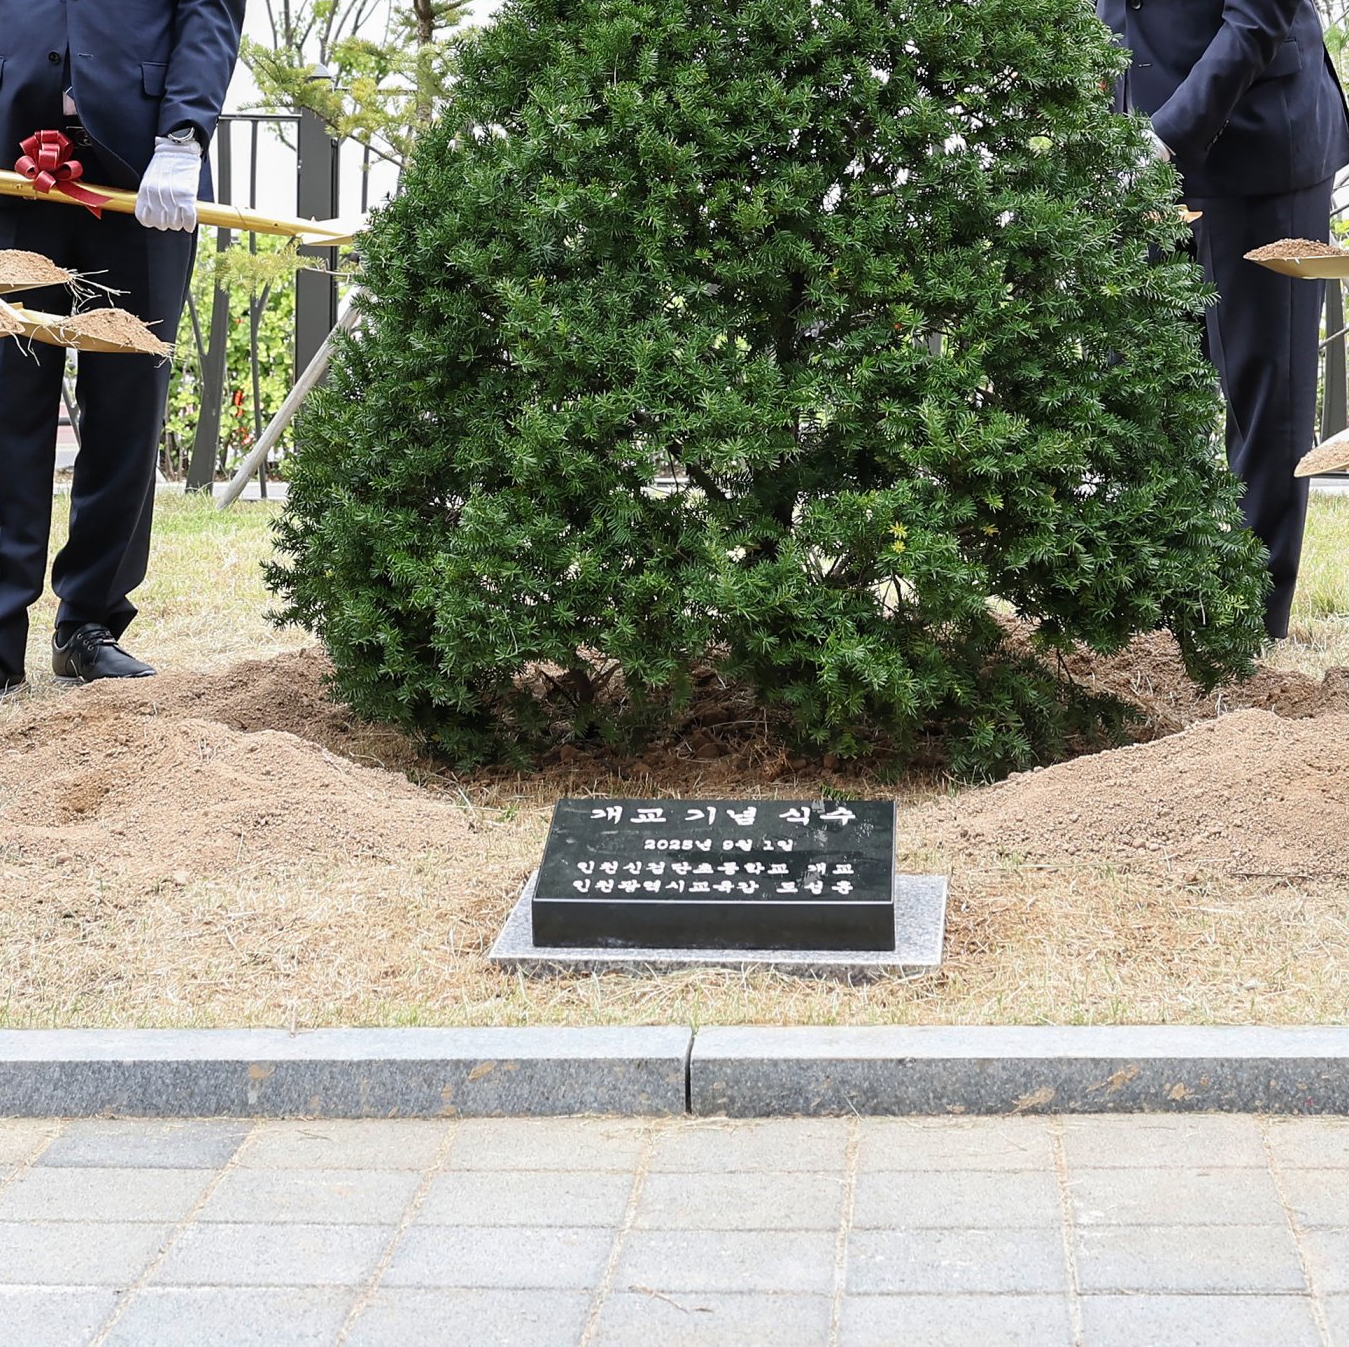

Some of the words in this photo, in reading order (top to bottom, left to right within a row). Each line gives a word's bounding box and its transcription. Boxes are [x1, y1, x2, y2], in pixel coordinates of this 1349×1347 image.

[590, 805, 667, 825] 개교
[684, 806, 757, 826] 기념
[778, 806, 856, 826] 식수
[644, 838, 712, 852] 2025년
[722, 838, 753, 852] 9월
[762, 838, 794, 852] 1일
[572, 878, 760, 894] 인천광역시교육감
